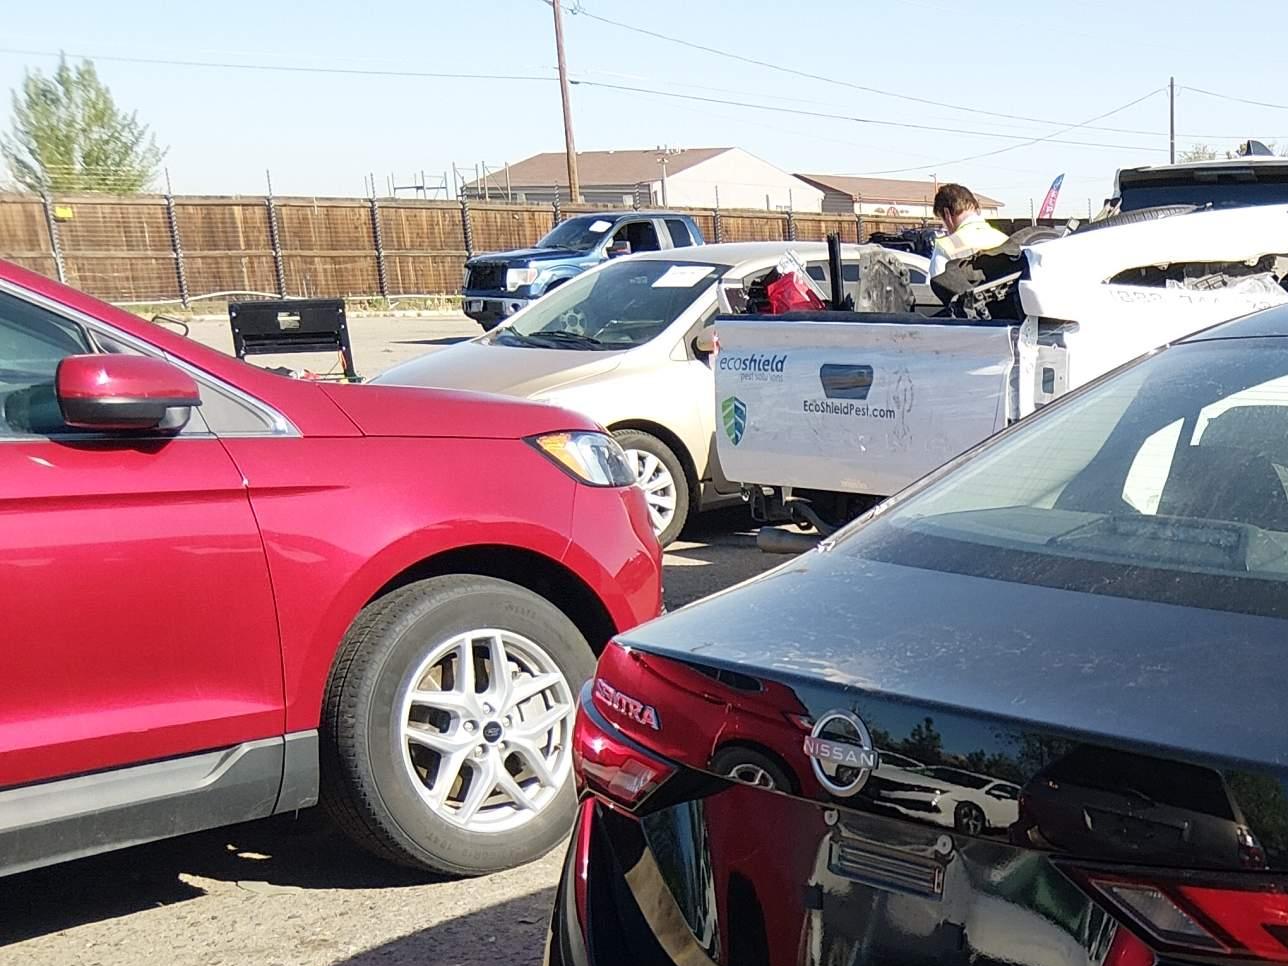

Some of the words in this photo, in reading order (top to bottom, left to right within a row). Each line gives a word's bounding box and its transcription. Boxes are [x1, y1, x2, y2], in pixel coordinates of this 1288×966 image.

[719, 353, 788, 373] ecoshield
[803, 399, 897, 419] EcoShieldPest.com
[595, 678, 661, 731] SENTRA
[803, 738, 875, 768] NISSAN
